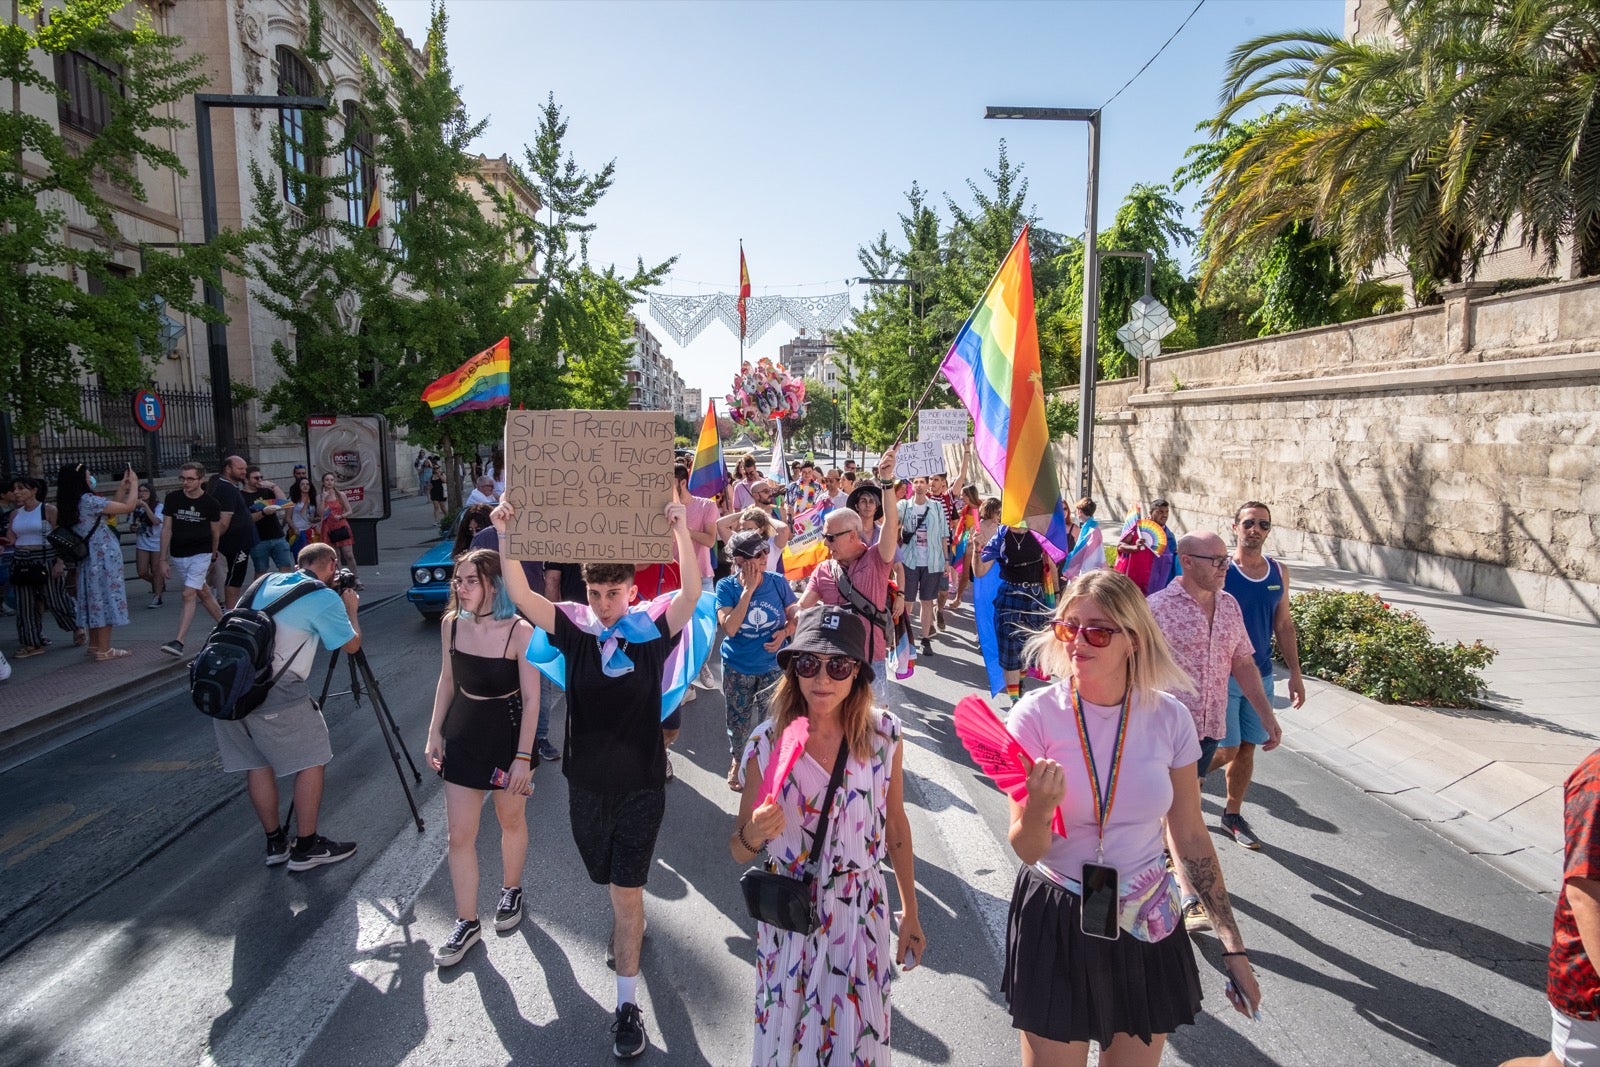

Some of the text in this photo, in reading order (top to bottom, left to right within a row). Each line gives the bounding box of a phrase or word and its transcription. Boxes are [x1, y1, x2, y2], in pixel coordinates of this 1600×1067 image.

[147, 406, 152, 414] P
[512, 412, 674, 442] SI TE PREGUNTAS
[512, 440, 671, 465] POR QUÉ TENGO
[896, 449, 937, 463] BREAK THE
[922, 441, 933, 450] TO
[511, 464, 674, 492] MIEDO, QUE SEPAS
[895, 456, 944, 478] CIS-TEM
[509, 486, 652, 510] QUE ES POR TI
[511, 511, 671, 537] Y POR LO QUE NO
[509, 534, 670, 559] ENSEÑAS A TUS HIJOS
